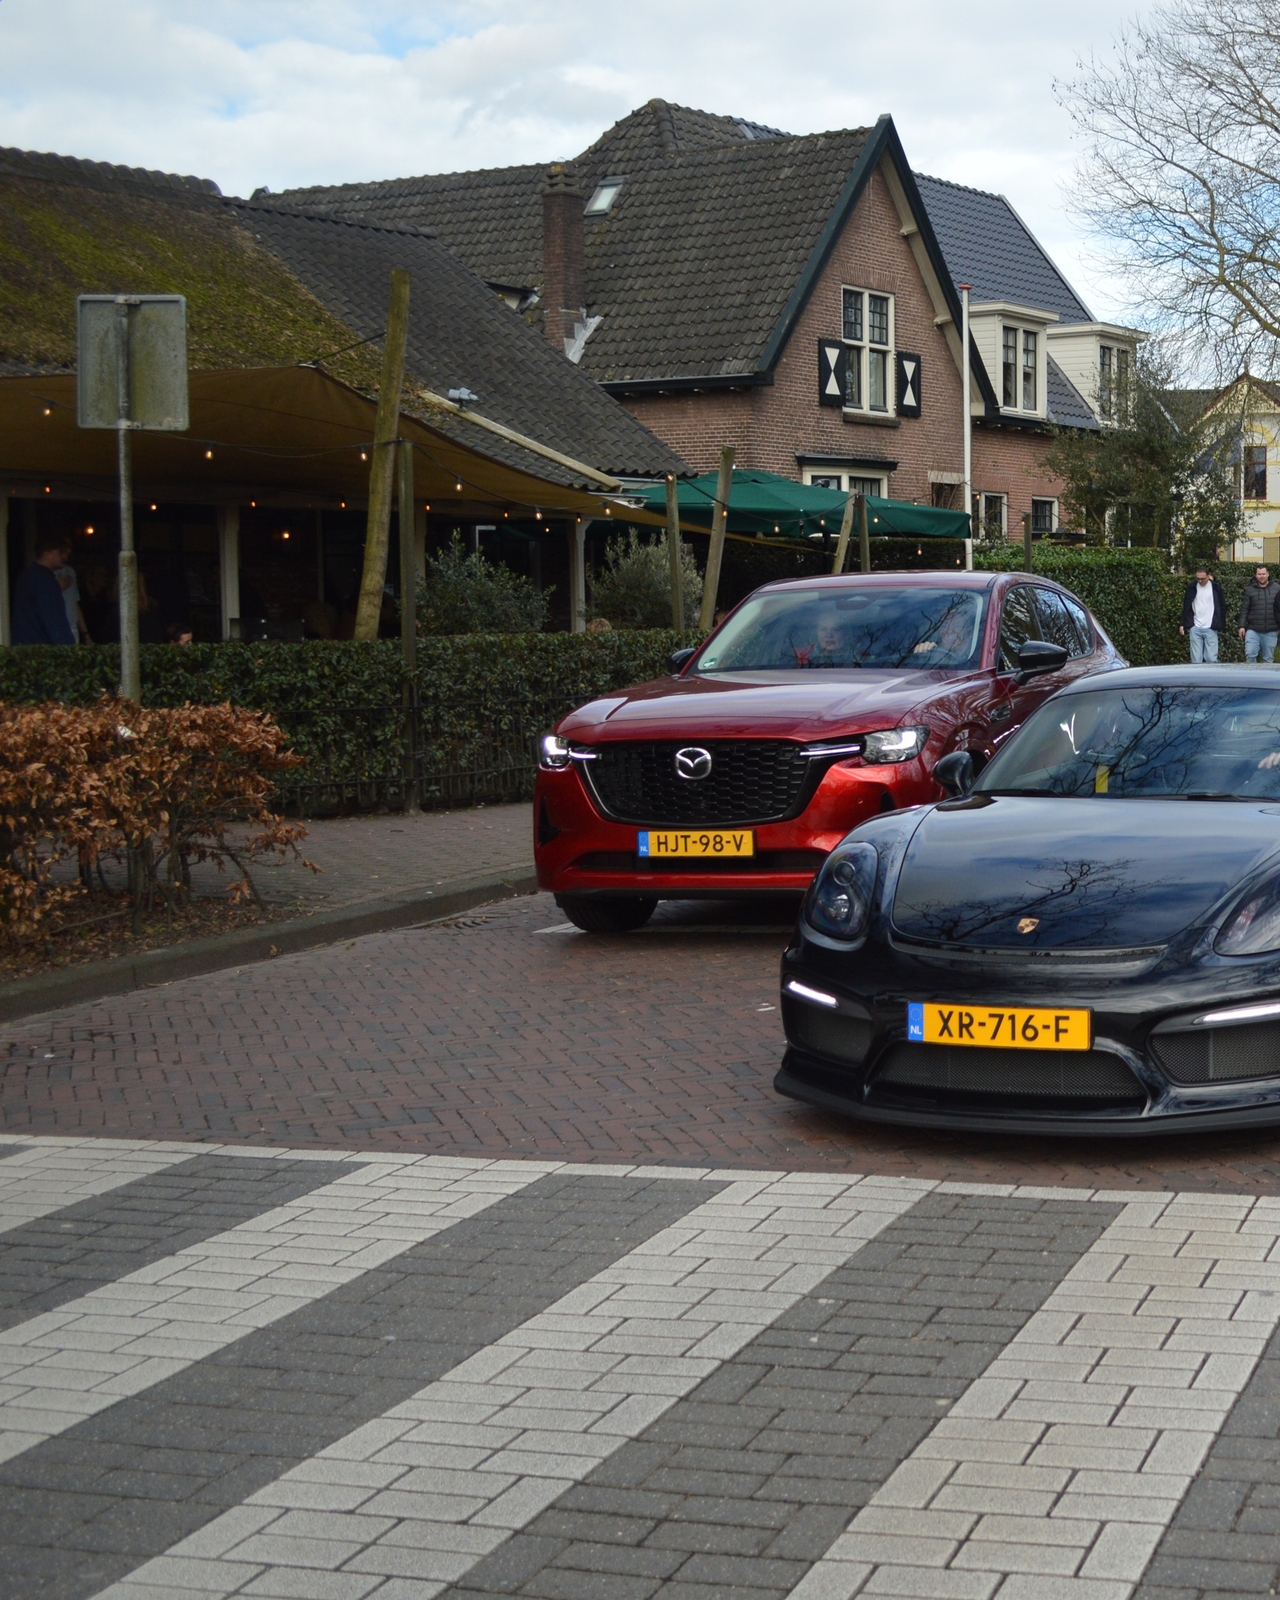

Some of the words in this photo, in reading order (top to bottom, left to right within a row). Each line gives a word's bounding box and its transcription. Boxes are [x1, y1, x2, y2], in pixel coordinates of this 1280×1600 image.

[656, 834, 744, 853] HJT-98-V
[910, 1025, 922, 1035] NL
[938, 1010, 1070, 1042] XR-716-F
